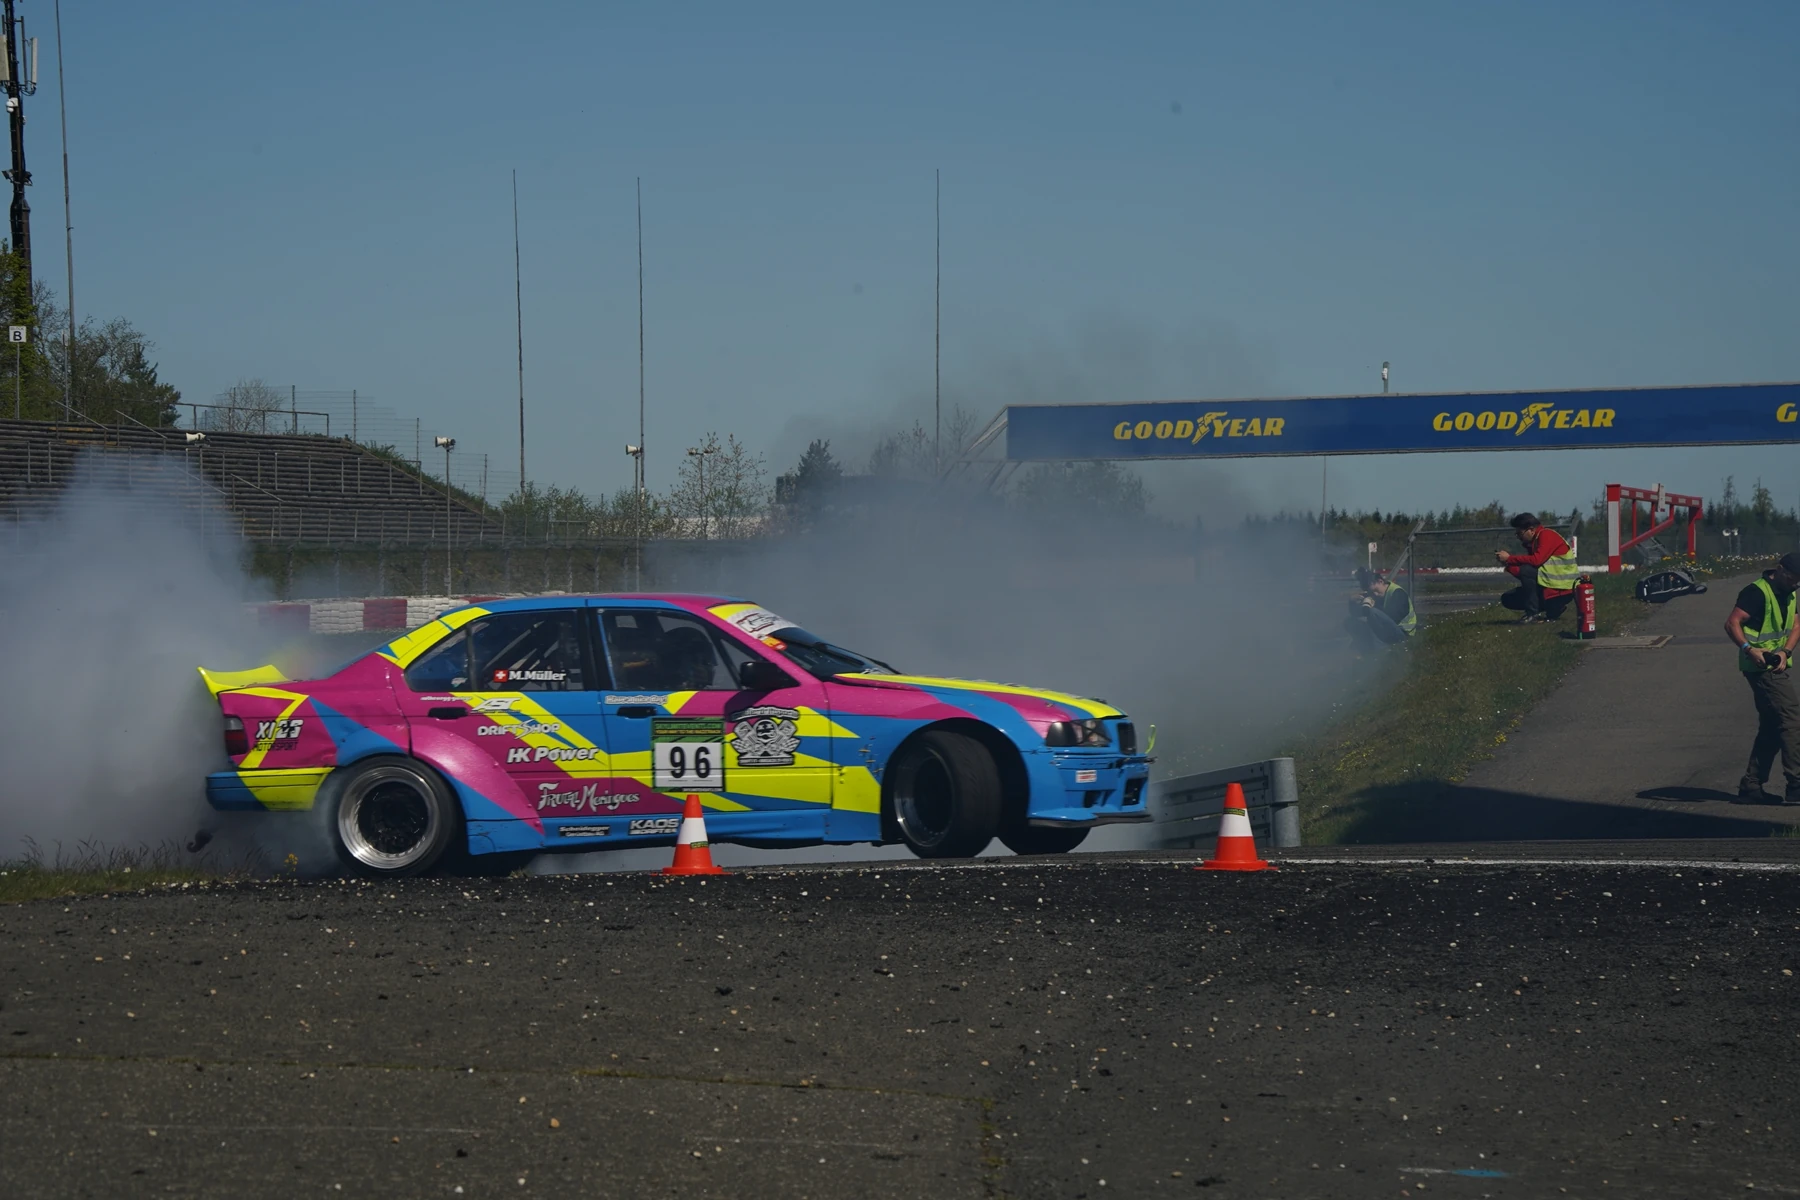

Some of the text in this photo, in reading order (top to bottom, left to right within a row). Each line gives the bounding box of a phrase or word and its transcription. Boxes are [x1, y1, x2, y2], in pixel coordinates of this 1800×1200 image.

[13, 330, 22, 341] B
[508, 670, 567, 681] M.Müller
[507, 746, 599, 763] HK Power
[630, 818, 679, 830] KAOS
